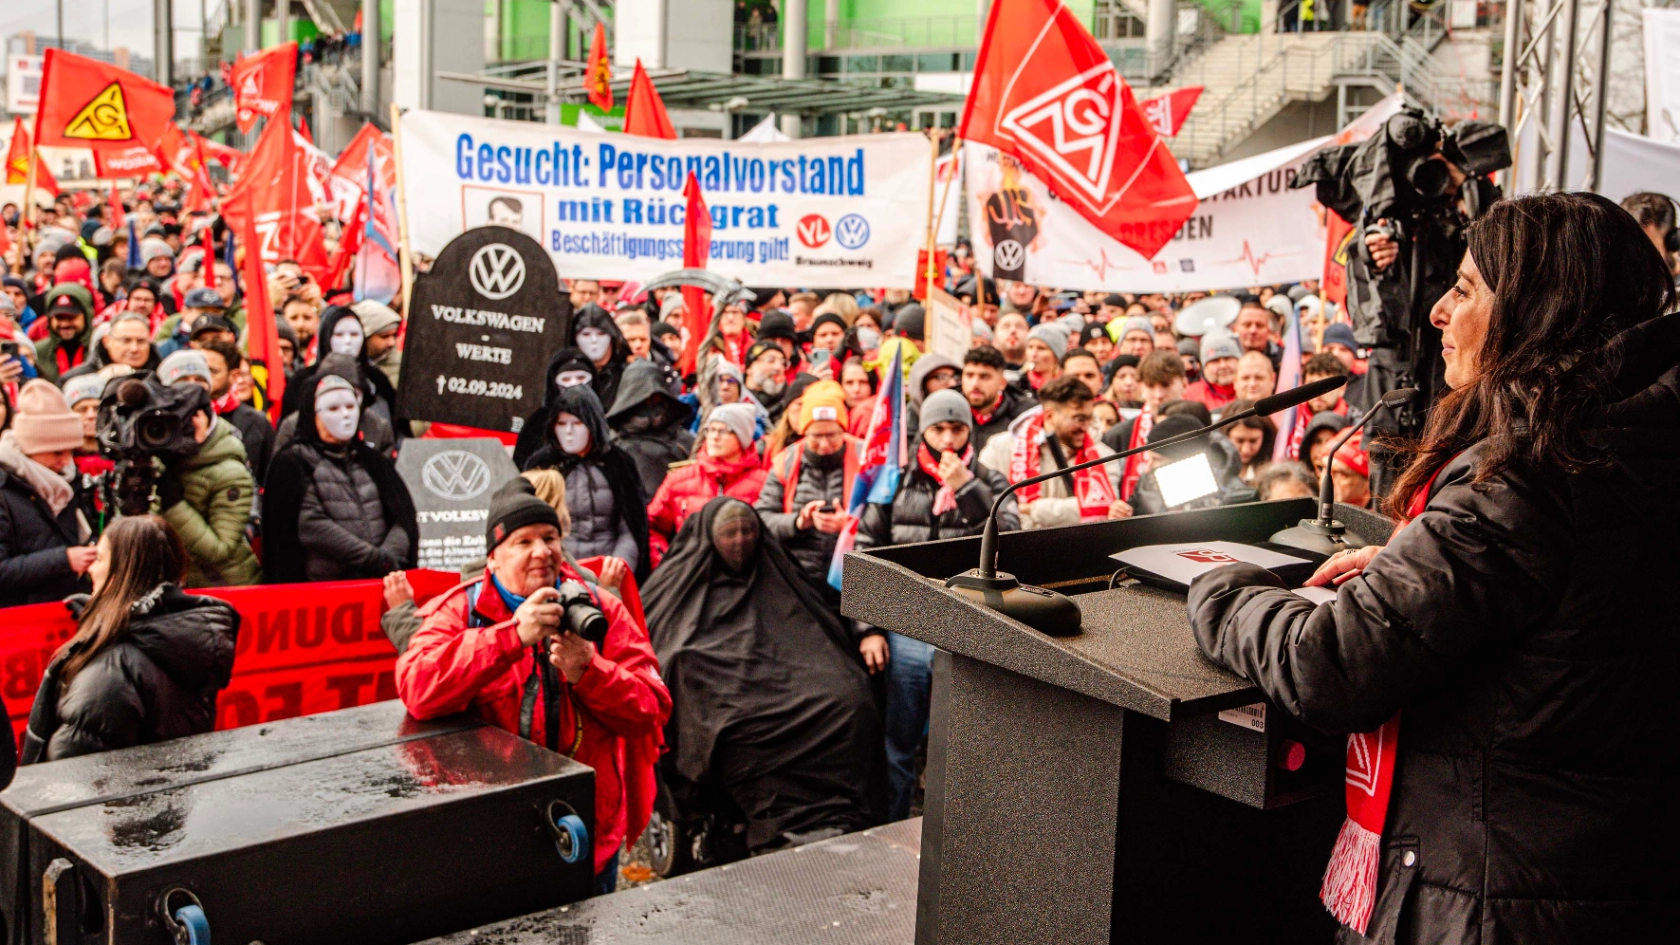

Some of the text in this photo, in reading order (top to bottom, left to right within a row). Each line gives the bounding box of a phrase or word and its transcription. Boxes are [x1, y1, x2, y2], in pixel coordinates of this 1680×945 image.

[456, 133, 865, 196] Gesucht: Personalvorstand
[558, 197, 779, 231] mit Rücgrat
[551, 229, 789, 264] Beschäftigungsserung gilt!
[431, 304, 546, 334] VOLKSWAGEN
[455, 343, 513, 365] WERTE
[447, 376, 523, 400] 02.09.2024
[1251, 719, 1264, 729] 003
